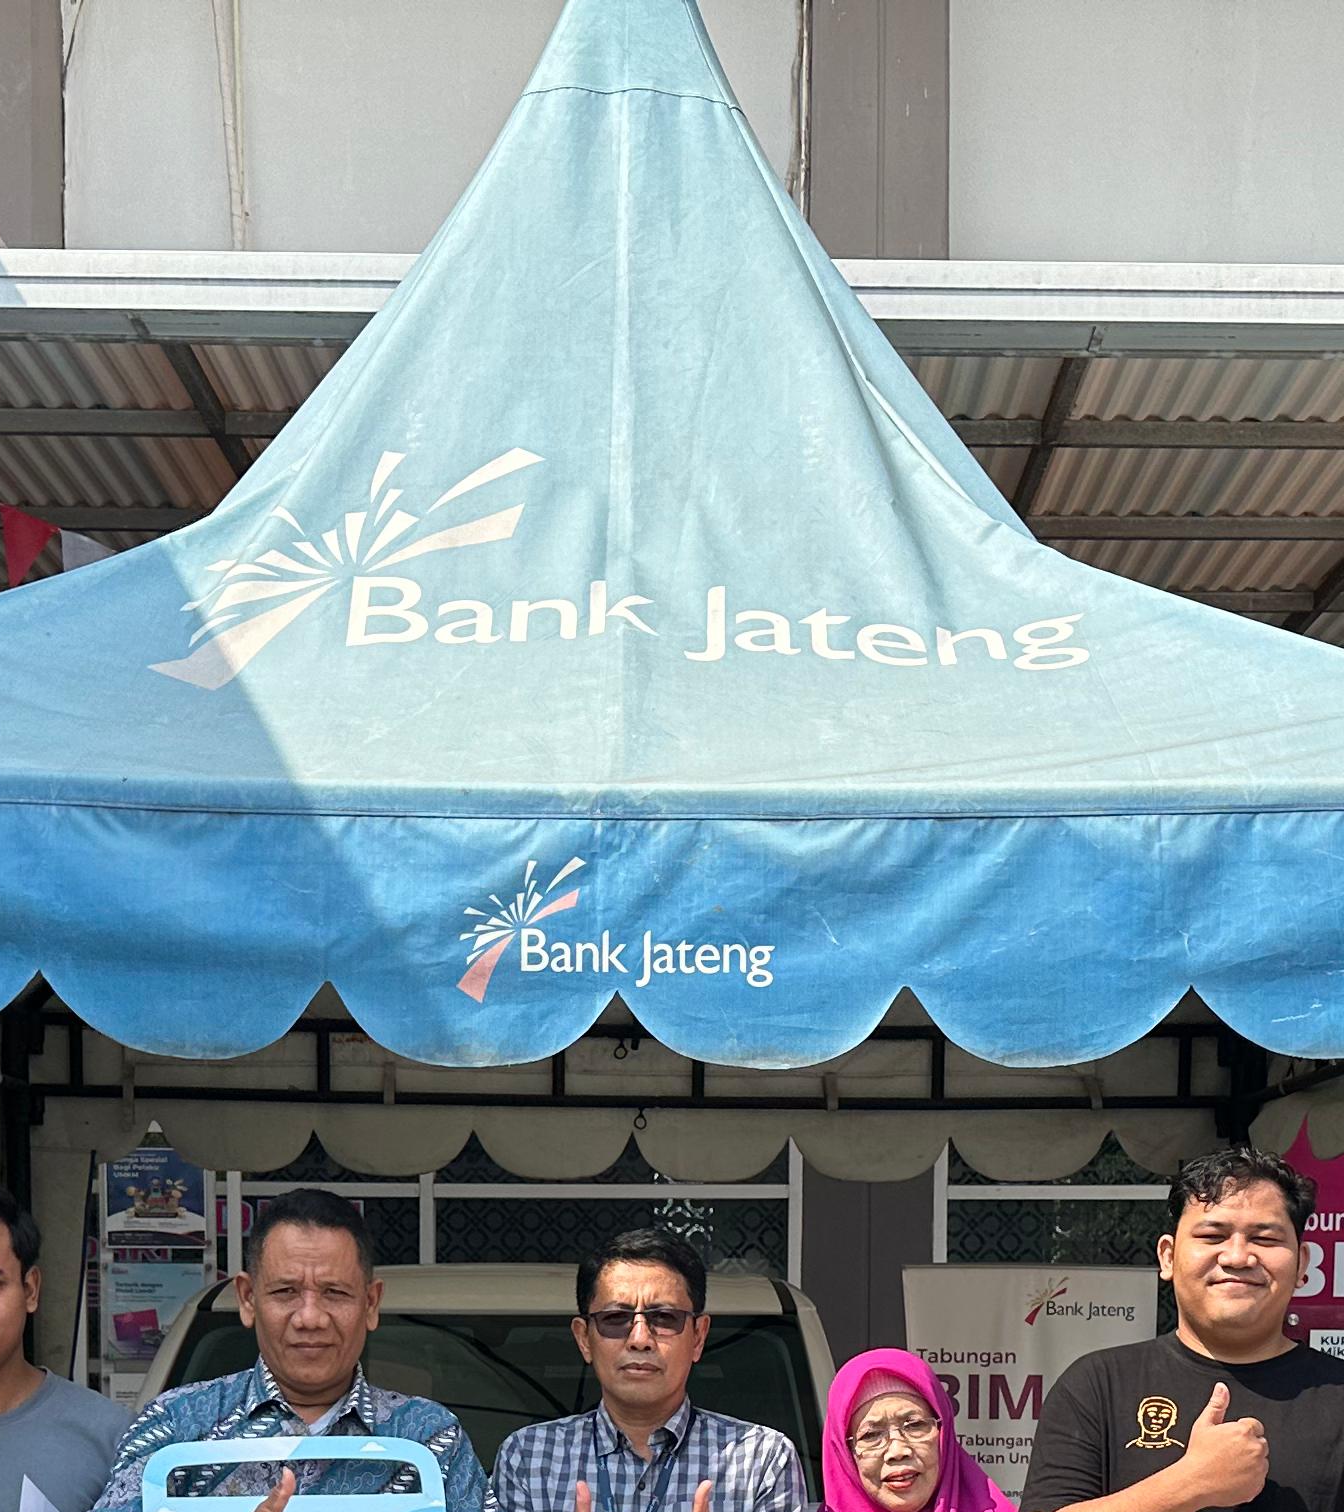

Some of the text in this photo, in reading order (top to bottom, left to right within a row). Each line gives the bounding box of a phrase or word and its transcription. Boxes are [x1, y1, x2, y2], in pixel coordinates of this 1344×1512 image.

[345, 576, 1092, 671] Bank Jateng
[520, 927, 776, 988] Bank Jateng
[1046, 1301, 1135, 1321] Bank Jateng
[916, 1349, 1017, 1367] Tabungan
[957, 1434, 1033, 1449] Tabungan
